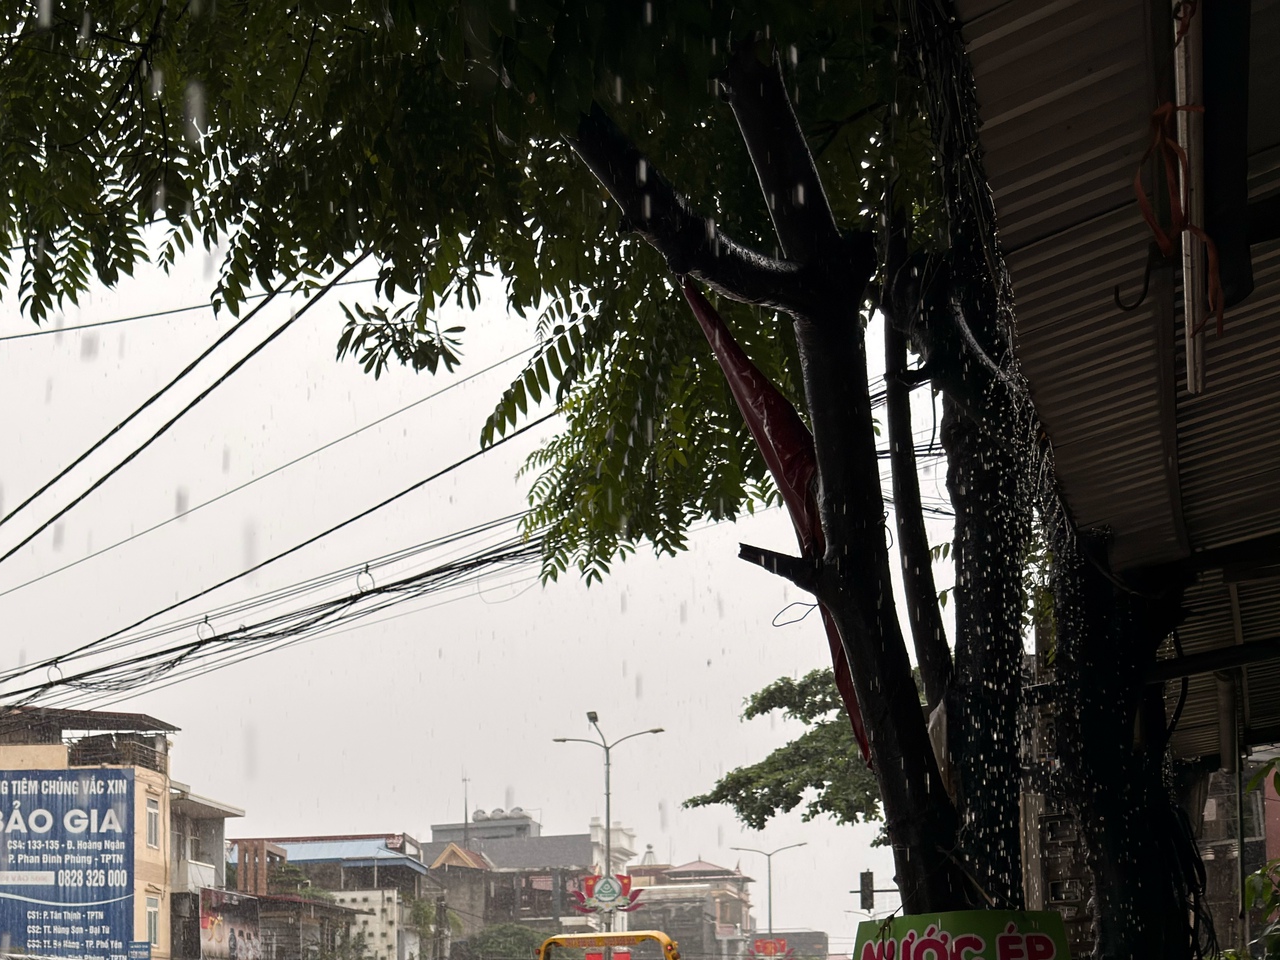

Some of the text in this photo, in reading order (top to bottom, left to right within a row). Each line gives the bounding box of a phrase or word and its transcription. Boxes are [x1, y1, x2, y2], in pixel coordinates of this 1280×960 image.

[11, 778, 38, 796] TIÊM
[41, 776, 79, 796] CHỦNG
[82, 776, 105, 795] VẮC
[107, 779, 127, 795] XIN
[64, 809, 123, 833] GIA
[27, 839, 60, 850] 133-135
[18, 854, 40, 864] Phan
[101, 854, 124, 864] TPTN
[58, 869, 84, 887] 0828
[86, 869, 106, 887] 326
[108, 869, 128, 887] 000
[27, 911, 42, 920] CS1:
[87, 911, 104, 920] TPTN
[27, 925, 42, 934] CS2:
